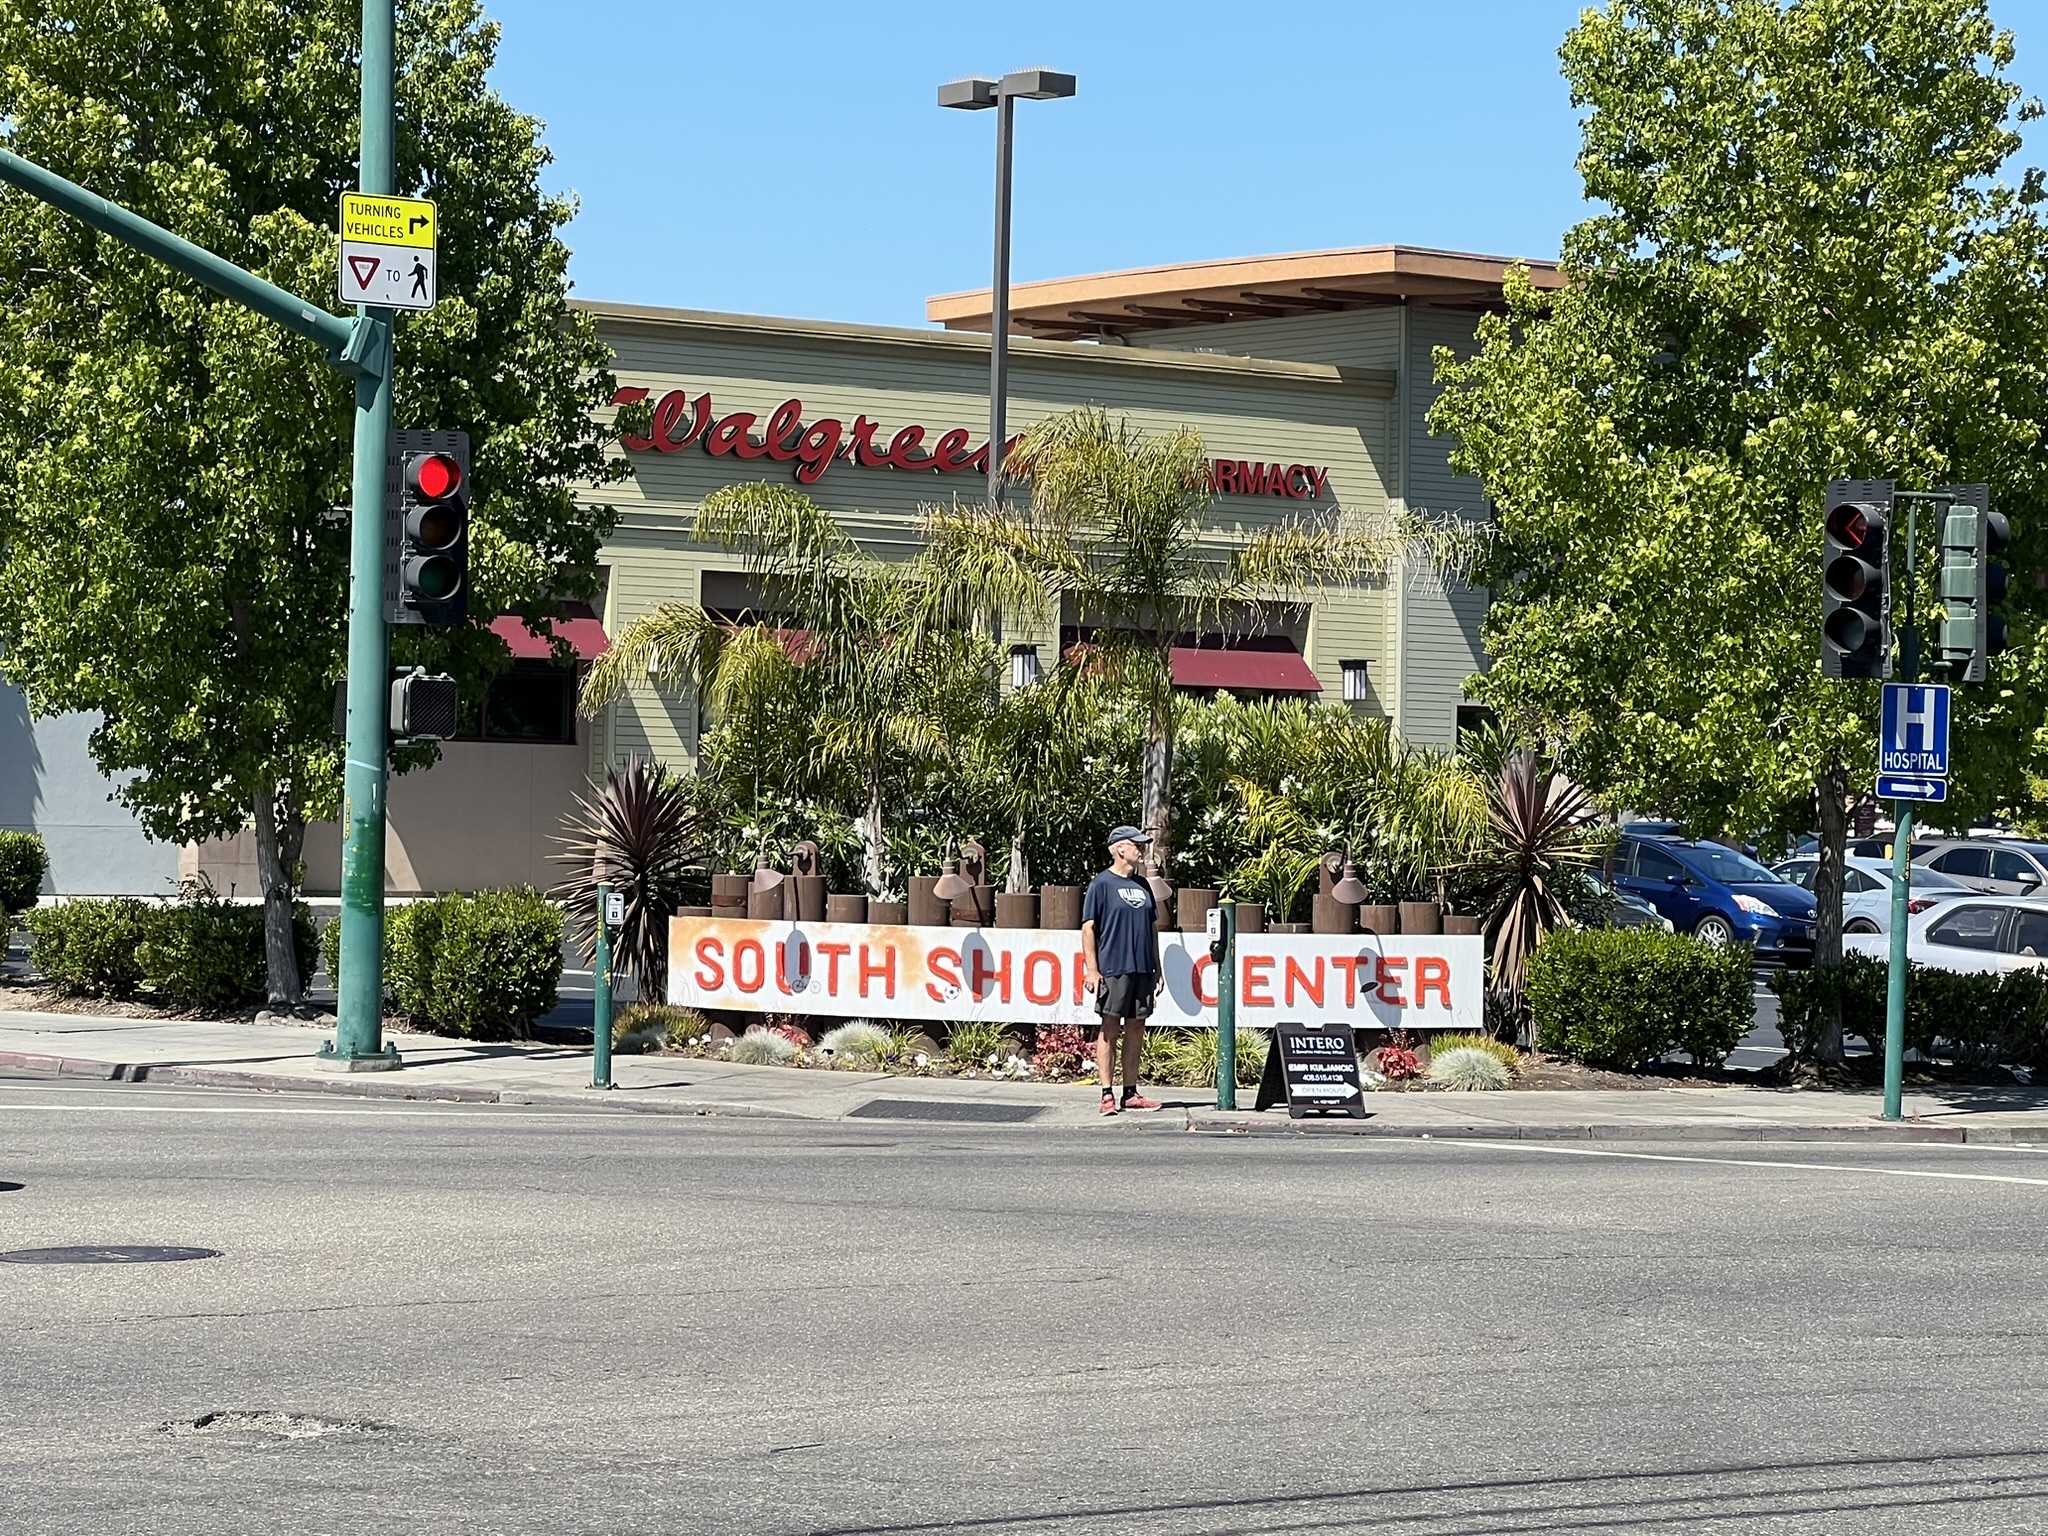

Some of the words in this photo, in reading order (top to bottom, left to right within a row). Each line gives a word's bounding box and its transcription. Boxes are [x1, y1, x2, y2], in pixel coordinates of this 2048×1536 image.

[349, 202, 401, 219] TURNING
[346, 222, 404, 239] VEHICLES
[386, 269, 401, 282] TO
[1895, 687, 1936, 751] H
[1884, 751, 1944, 770] HOSPITAL
[694, 936, 897, 999] SOUTH
[926, 945, 1156, 1008] SHO
[1191, 955, 1452, 1010] CENTER
[1290, 1037, 1345, 1050] INTERO
